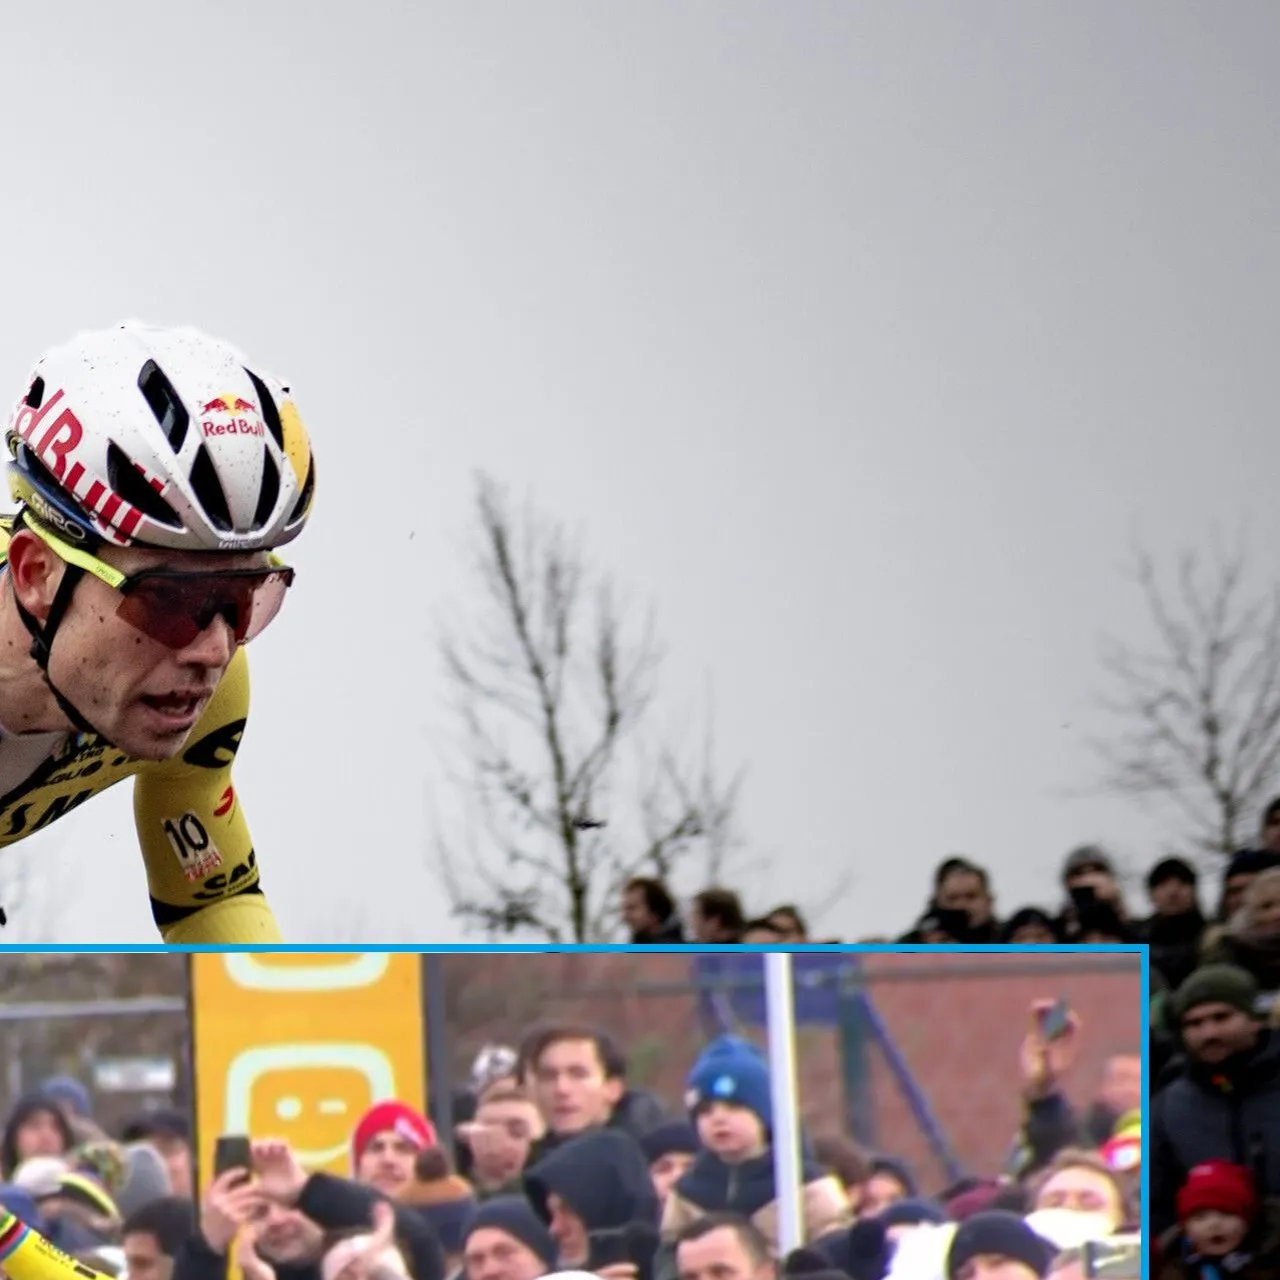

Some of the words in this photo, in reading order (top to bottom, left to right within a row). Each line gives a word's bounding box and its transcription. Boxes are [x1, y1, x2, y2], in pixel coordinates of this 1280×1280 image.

[203, 419, 237, 437] Red
[239, 418, 265, 437] Bull
[163, 812, 210, 858] 10
